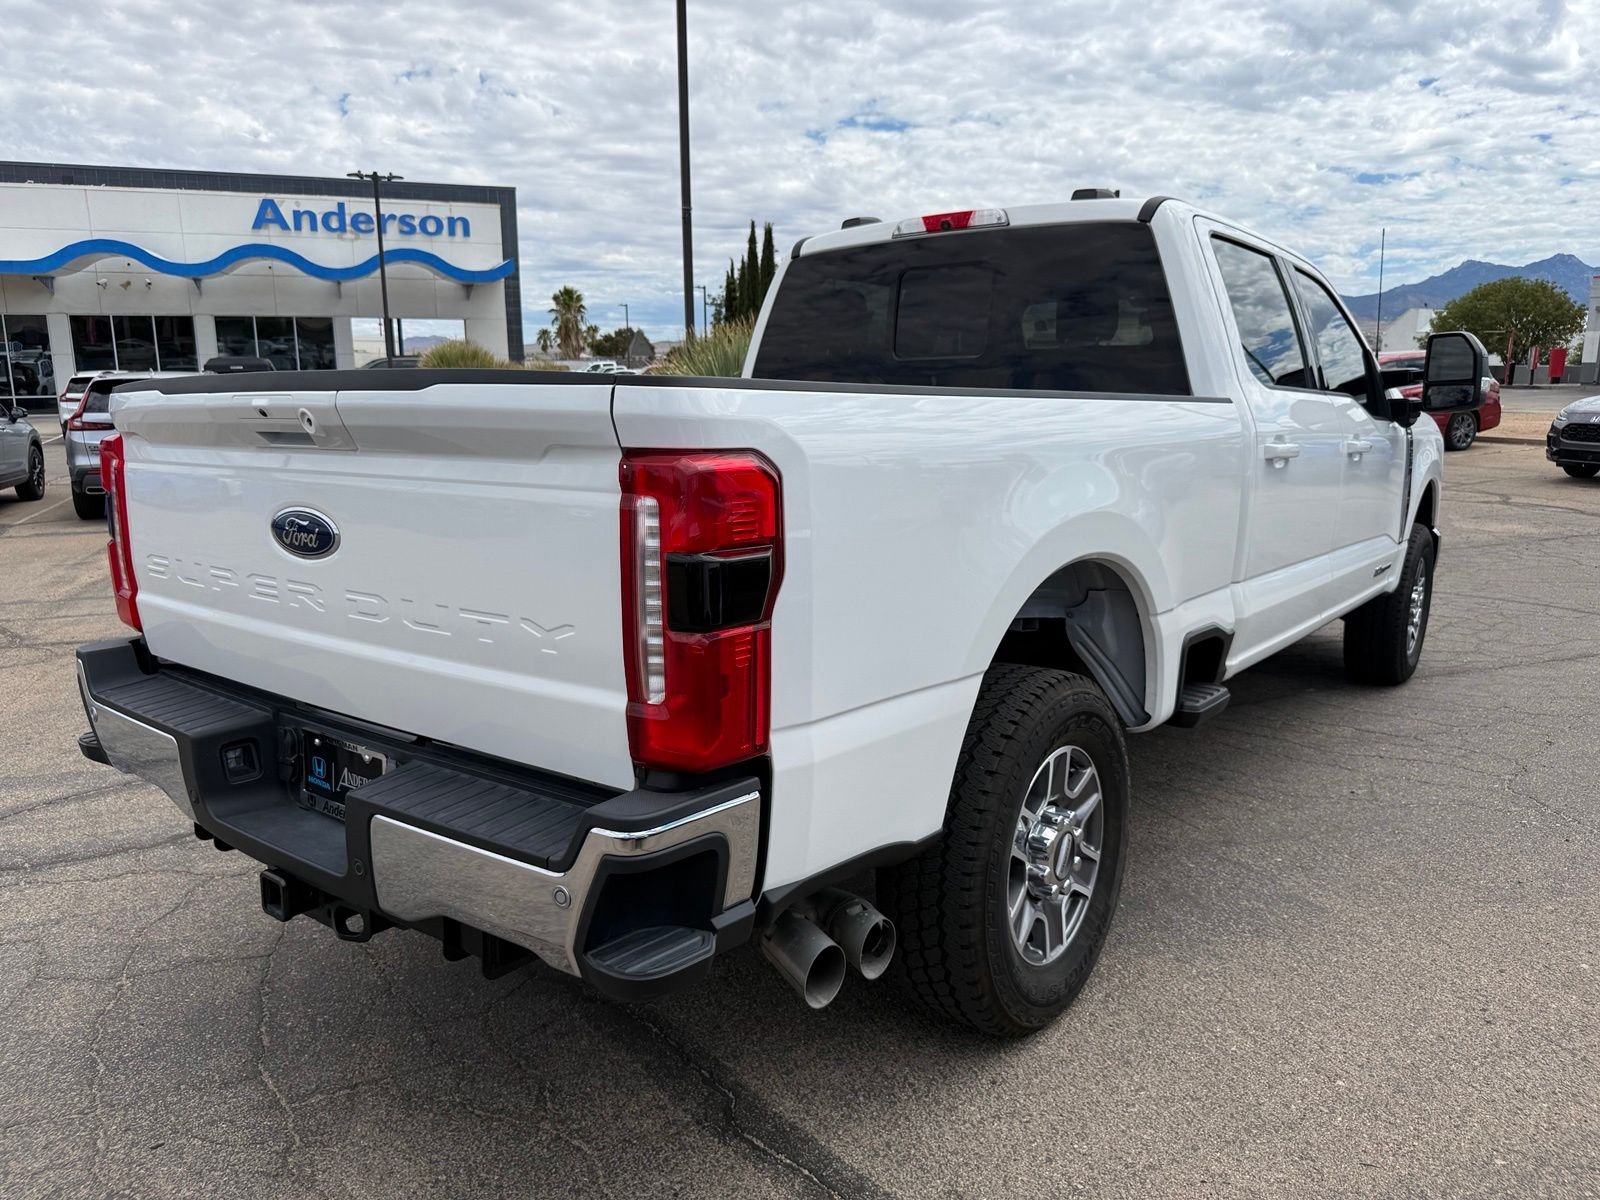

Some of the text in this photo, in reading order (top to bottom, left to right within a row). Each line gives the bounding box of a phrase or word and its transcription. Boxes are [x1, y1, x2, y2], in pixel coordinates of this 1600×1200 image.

[251, 198, 471, 238] Anderson
[283, 517, 320, 548] Ford
[147, 554, 575, 654] SUPER DUTY
